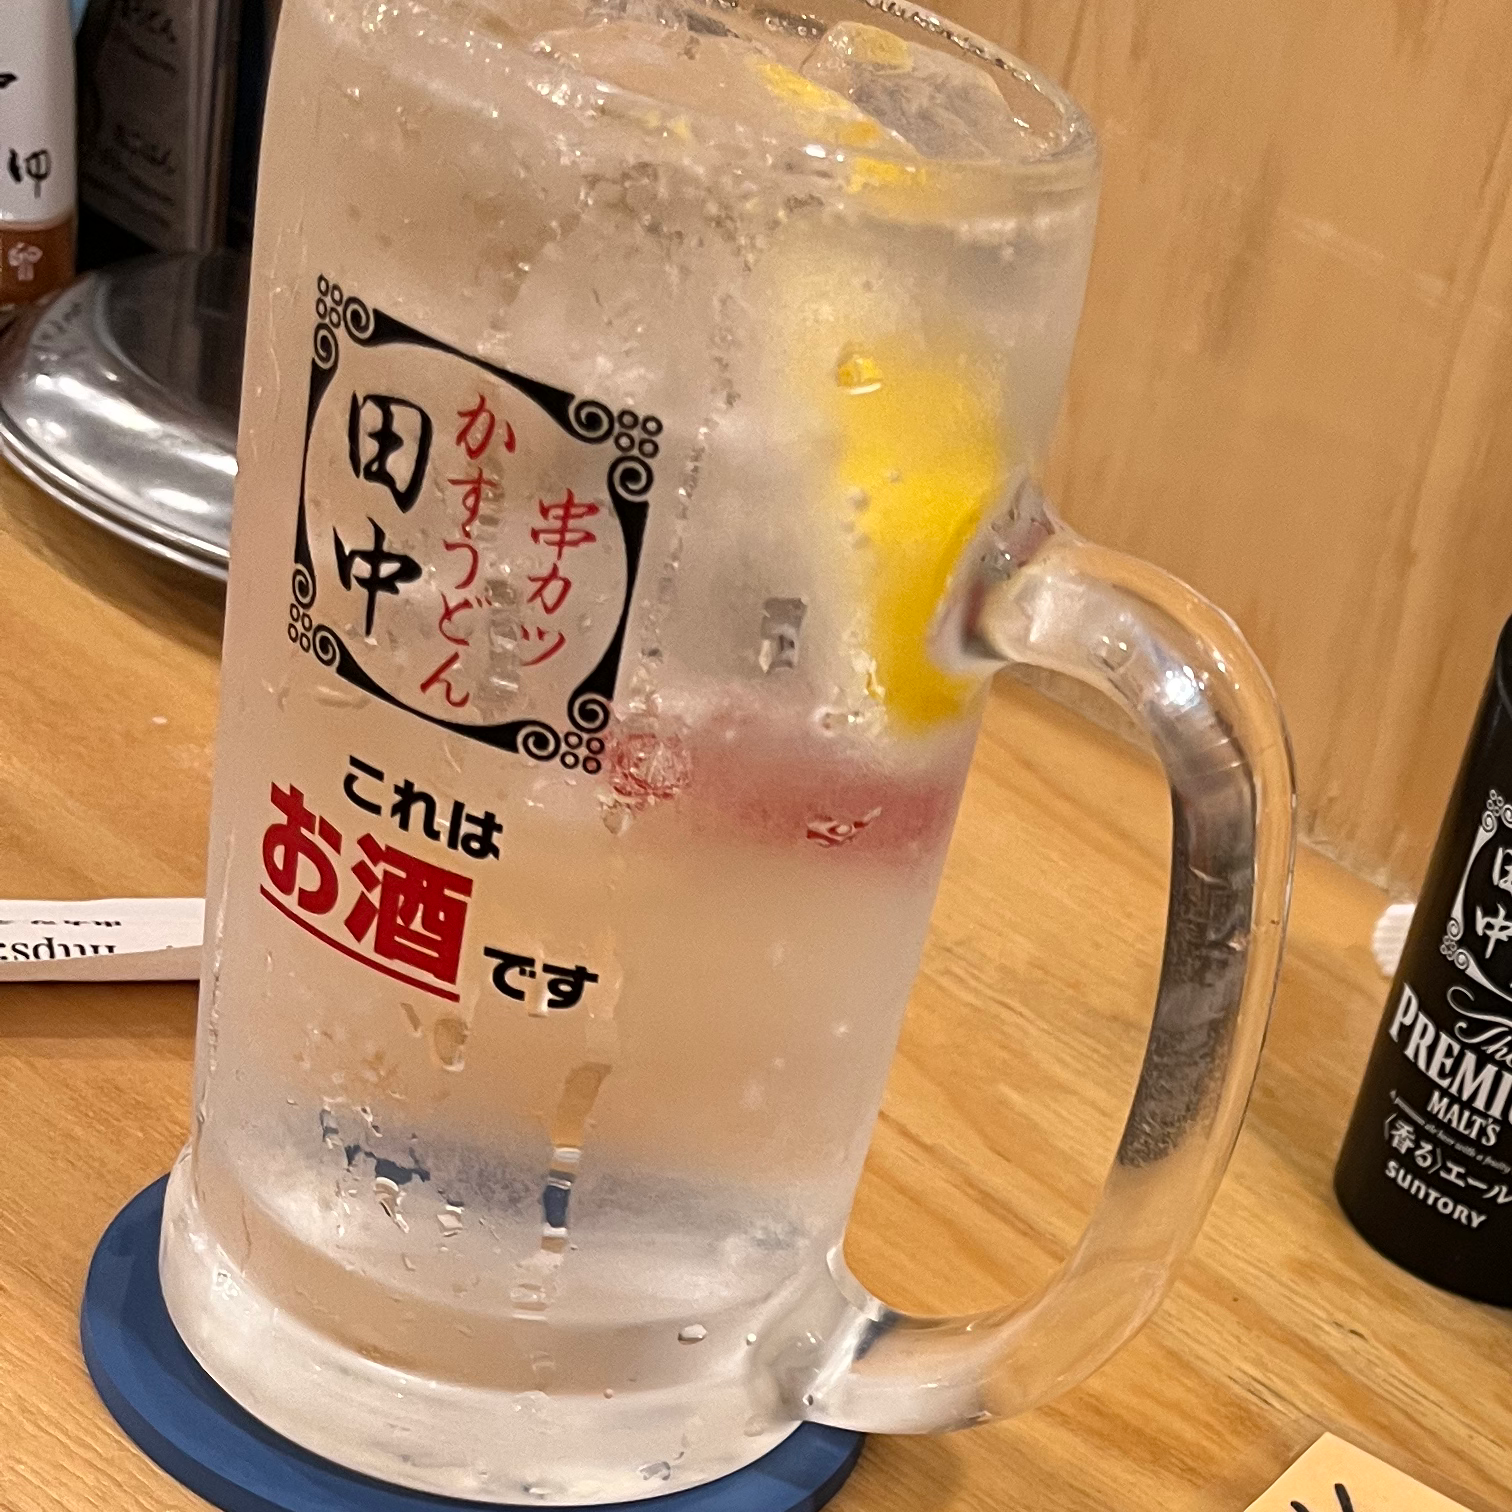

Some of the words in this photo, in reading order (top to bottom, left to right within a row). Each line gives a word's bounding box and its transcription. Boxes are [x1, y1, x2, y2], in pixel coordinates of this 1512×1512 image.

[333, 391, 433, 636] 田中
[420, 394, 516, 708] かすうどん
[521, 488, 600, 667] 串カツ
[260, 782, 474, 986] お酒
[484, 946, 599, 1009] です
[343, 755, 503, 860] これは
[1427, 1090, 1501, 1147] MALT'S
